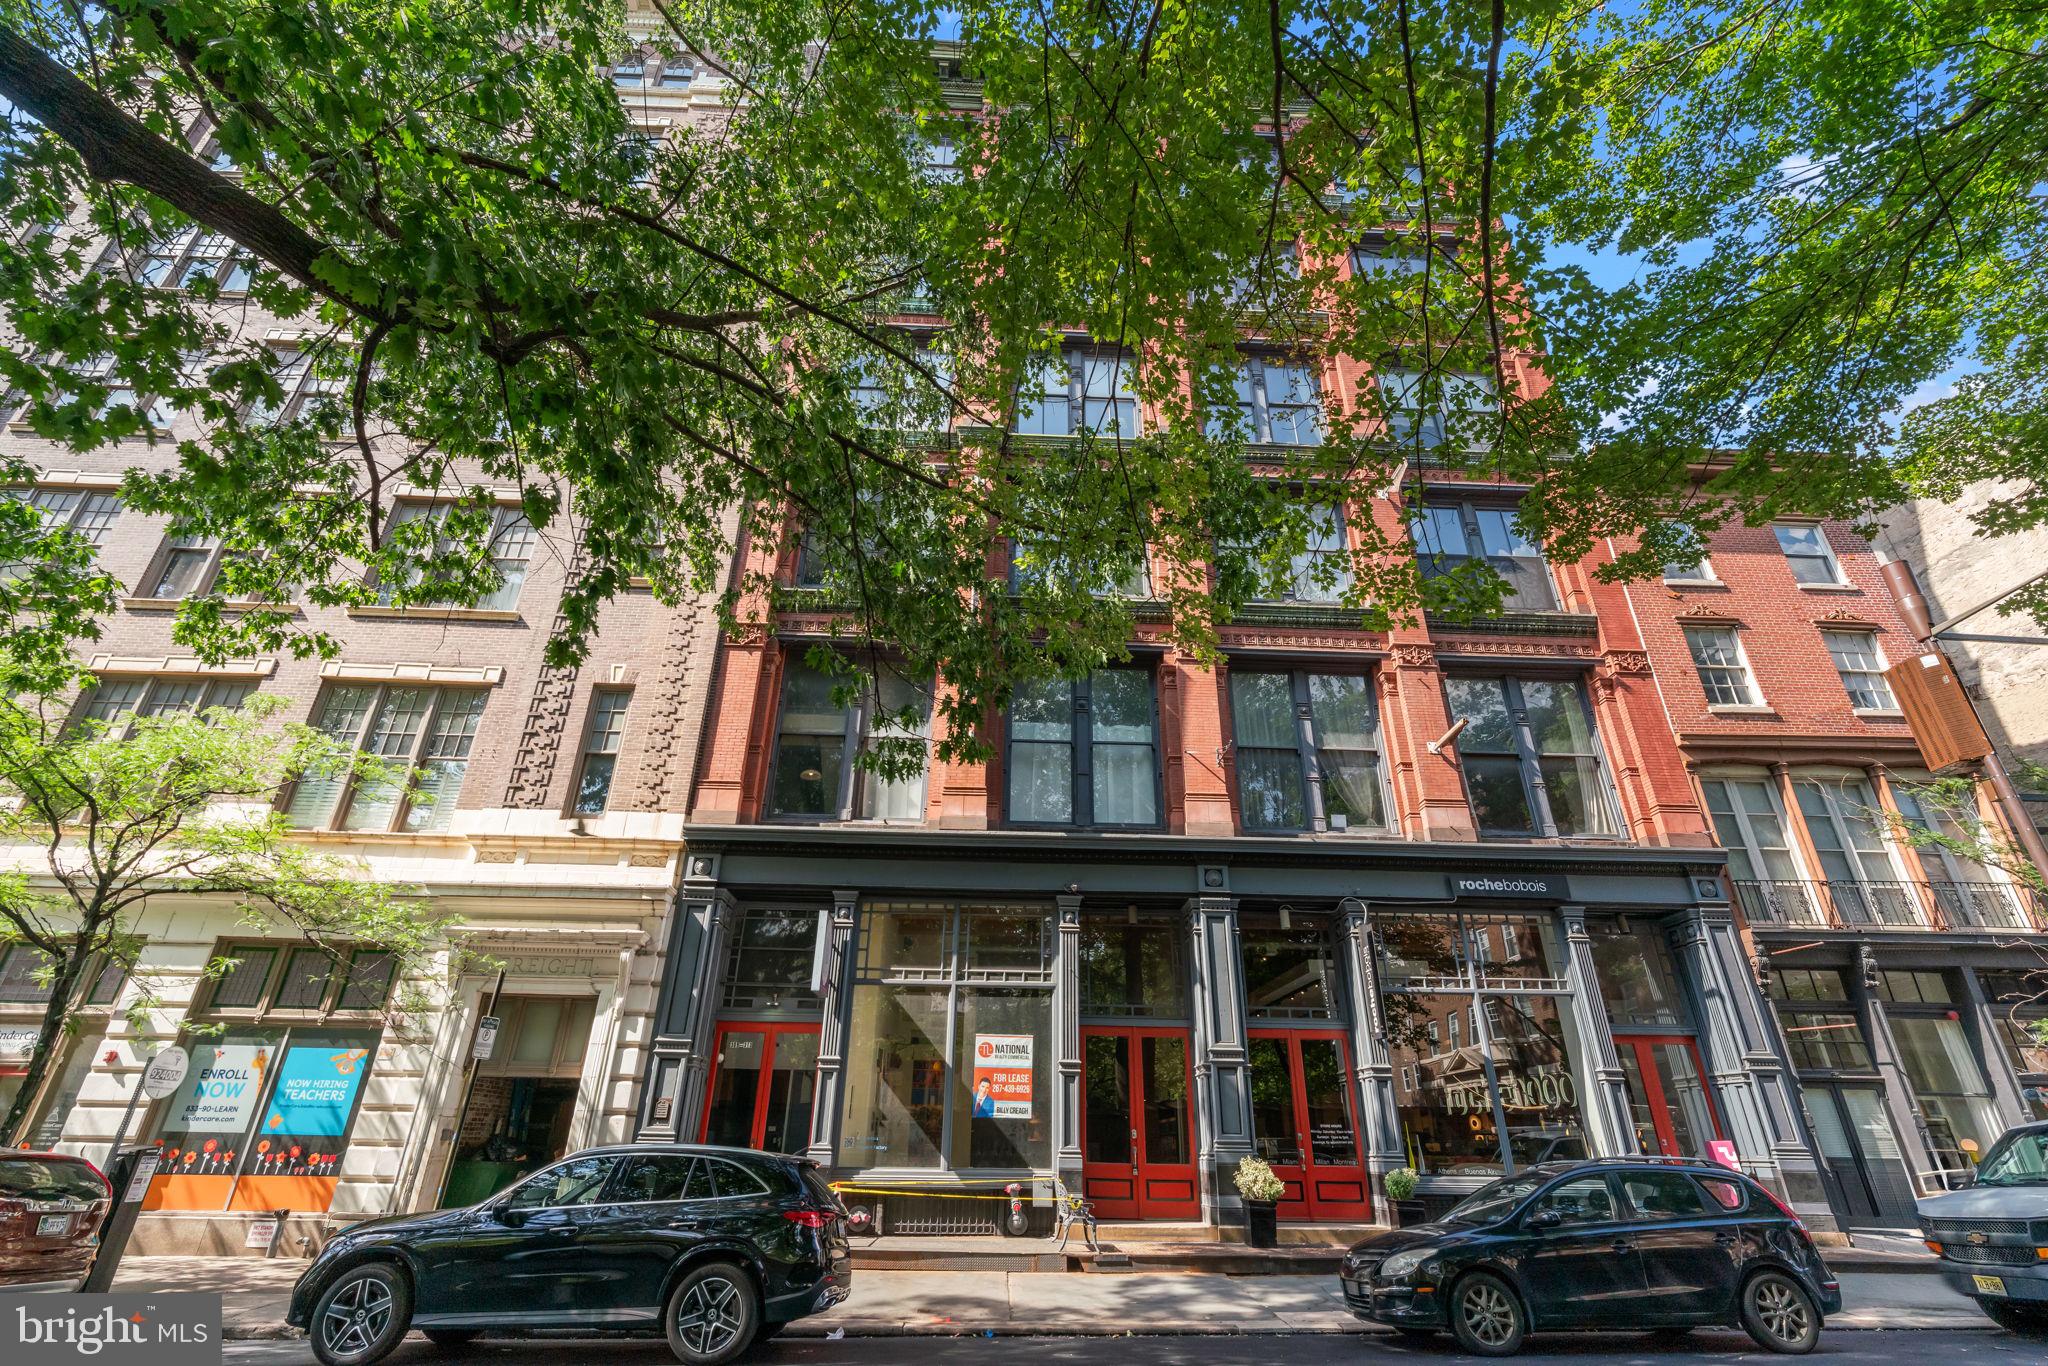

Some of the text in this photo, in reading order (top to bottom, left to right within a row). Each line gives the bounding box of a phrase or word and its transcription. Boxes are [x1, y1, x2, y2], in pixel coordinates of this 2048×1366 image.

[1459, 878, 1547, 892] rochebobois
[995, 1044, 1030, 1055] NATIONAL
[150, 1068, 182, 1081] 924004
[200, 1069, 249, 1080] ENROLL
[993, 1073, 1030, 1083] FOR LEASE
[193, 1081, 246, 1098] NOW
[286, 1079, 349, 1089] NOW HIRING
[284, 1089, 346, 1101] TEACHERS
[185, 1105, 239, 1113] 833-90-LEARN
[181, 1114, 236, 1123] kindercare.com
